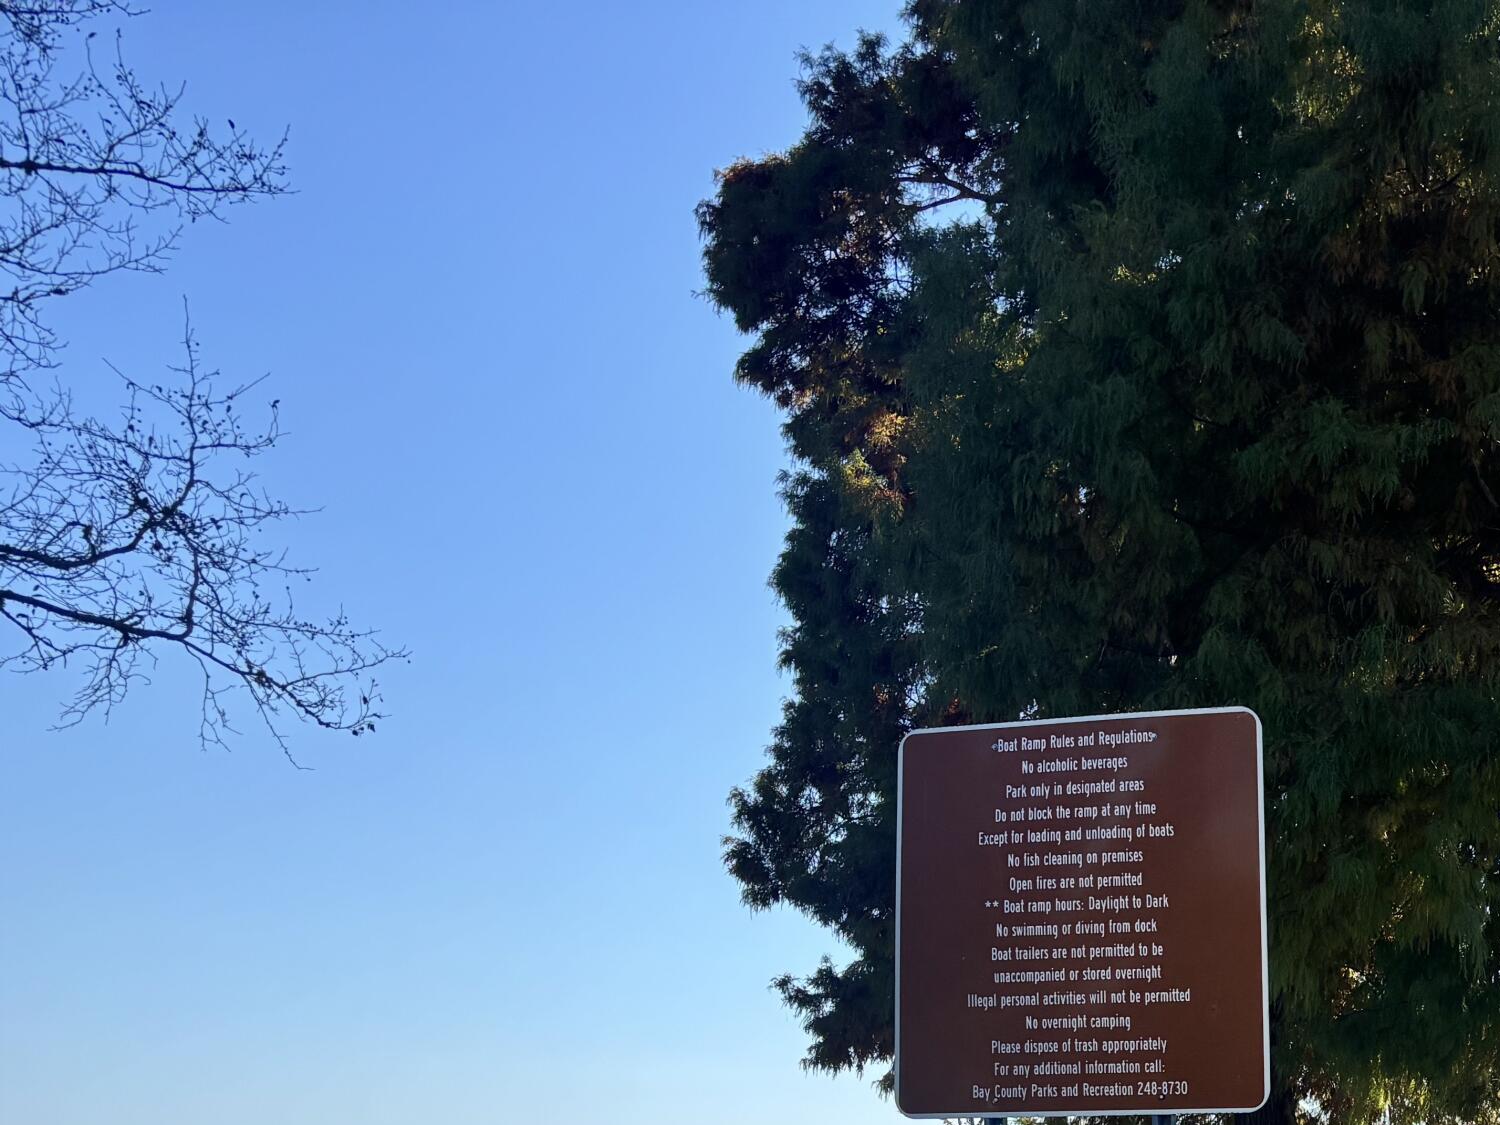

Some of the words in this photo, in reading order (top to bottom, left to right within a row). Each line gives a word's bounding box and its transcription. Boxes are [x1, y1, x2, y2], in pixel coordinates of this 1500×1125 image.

[998, 738, 1017, 752] Boat
[1022, 737, 1046, 752] Ramp
[1051, 734, 1074, 748] Rules
[1078, 732, 1094, 746] and
[1099, 729, 1153, 748] Regulations
[1022, 760, 1033, 774] No
[1037, 757, 1078, 773] alcoholic
[1082, 757, 1127, 772] beverages
[1006, 784, 1027, 798] Park
[1030, 783, 1050, 799] only
[1054, 782, 1062, 795] in
[1066, 779, 1115, 797] designated
[1119, 780, 1144, 791] areas
[995, 809, 1006, 822] Do
[1011, 808, 1024, 821] not
[1028, 806, 1052, 820] block
[1056, 806, 1070, 819] the
[1075, 807, 1098, 820] ramp
[1101, 803, 1110, 816] at
[1114, 805, 1131, 818] any
[1135, 801, 1156, 814] time
[979, 831, 1008, 847] Except
[1011, 830, 1024, 843] for
[1028, 828, 1061, 845] loading
[1065, 827, 1081, 841] and
[1086, 825, 1132, 842] unloading
[1136, 824, 1145, 837] of
[1149, 823, 1174, 837] boats
[1008, 854, 1019, 867] No
[1024, 853, 1039, 866] fish
[1044, 851, 1082, 868] cleaning
[1087, 853, 1097, 863] on
[1102, 849, 1143, 866] premises
[1010, 877, 1032, 893] Open
[1036, 876, 1056, 889] fires
[1060, 878, 1075, 888] are
[1079, 874, 1093, 888] not
[1098, 872, 1142, 890] permitted
[1004, 899, 1024, 913] Boat
[1028, 901, 1051, 914] ramp
[1056, 898, 1084, 911] hours:
[1089, 895, 1129, 913] Daylight
[1132, 895, 1141, 908] to
[1146, 894, 1168, 908] Dark
[997, 923, 1008, 937] No
[1012, 922, 1058, 939] swimming
[1062, 924, 1071, 935] or
[1076, 920, 1104, 937] diving
[1109, 919, 1130, 933] from
[1135, 918, 1157, 932] dock
[992, 947, 1011, 960] Boat
[1015, 946, 1048, 960] trailers
[1052, 948, 1067, 959] are
[1071, 945, 1086, 958] not
[1090, 943, 1134, 960] permitted
[1138, 943, 1147, 956] to
[1152, 942, 1163, 955] be
[994, 968, 1065, 984] unaccompanied
[1070, 970, 1079, 980] or
[1083, 966, 1111, 980] stored
[1116, 965, 1161, 983] overnight
[968, 994, 996, 1011] Illegal
[1001, 992, 1039, 1009] personal
[1043, 991, 1086, 1005] activities
[1089, 990, 1106, 1004] will
[1111, 990, 1126, 1003] not
[1130, 990, 1140, 1003] be
[1145, 988, 1190, 1005] permitted
[1026, 1016, 1038, 1029] No
[1042, 1015, 1087, 1032] overnight
[1091, 1014, 1130, 1031] camping
[992, 1040, 1020, 1053] Please
[1024, 1040, 1058, 1055] dispose
[1062, 1038, 1071, 1052] of
[1074, 1038, 1098, 1052] trash
[1102, 1037, 1167, 1054] appropriately
[995, 1063, 1009, 1075] For
[1013, 1065, 1030, 1078] any
[1034, 1061, 1081, 1075] additional
[1086, 1060, 1140, 1074] information
[1145, 1059, 1165, 1072] call:
[973, 1085, 990, 1101] Bay
[994, 1084, 1027, 1101] County
[1032, 1084, 1057, 1097] Parks
[1061, 1084, 1078, 1096] and
[1083, 1082, 1133, 1096] Recreation
[1138, 1081, 1188, 1096] 248-8730
